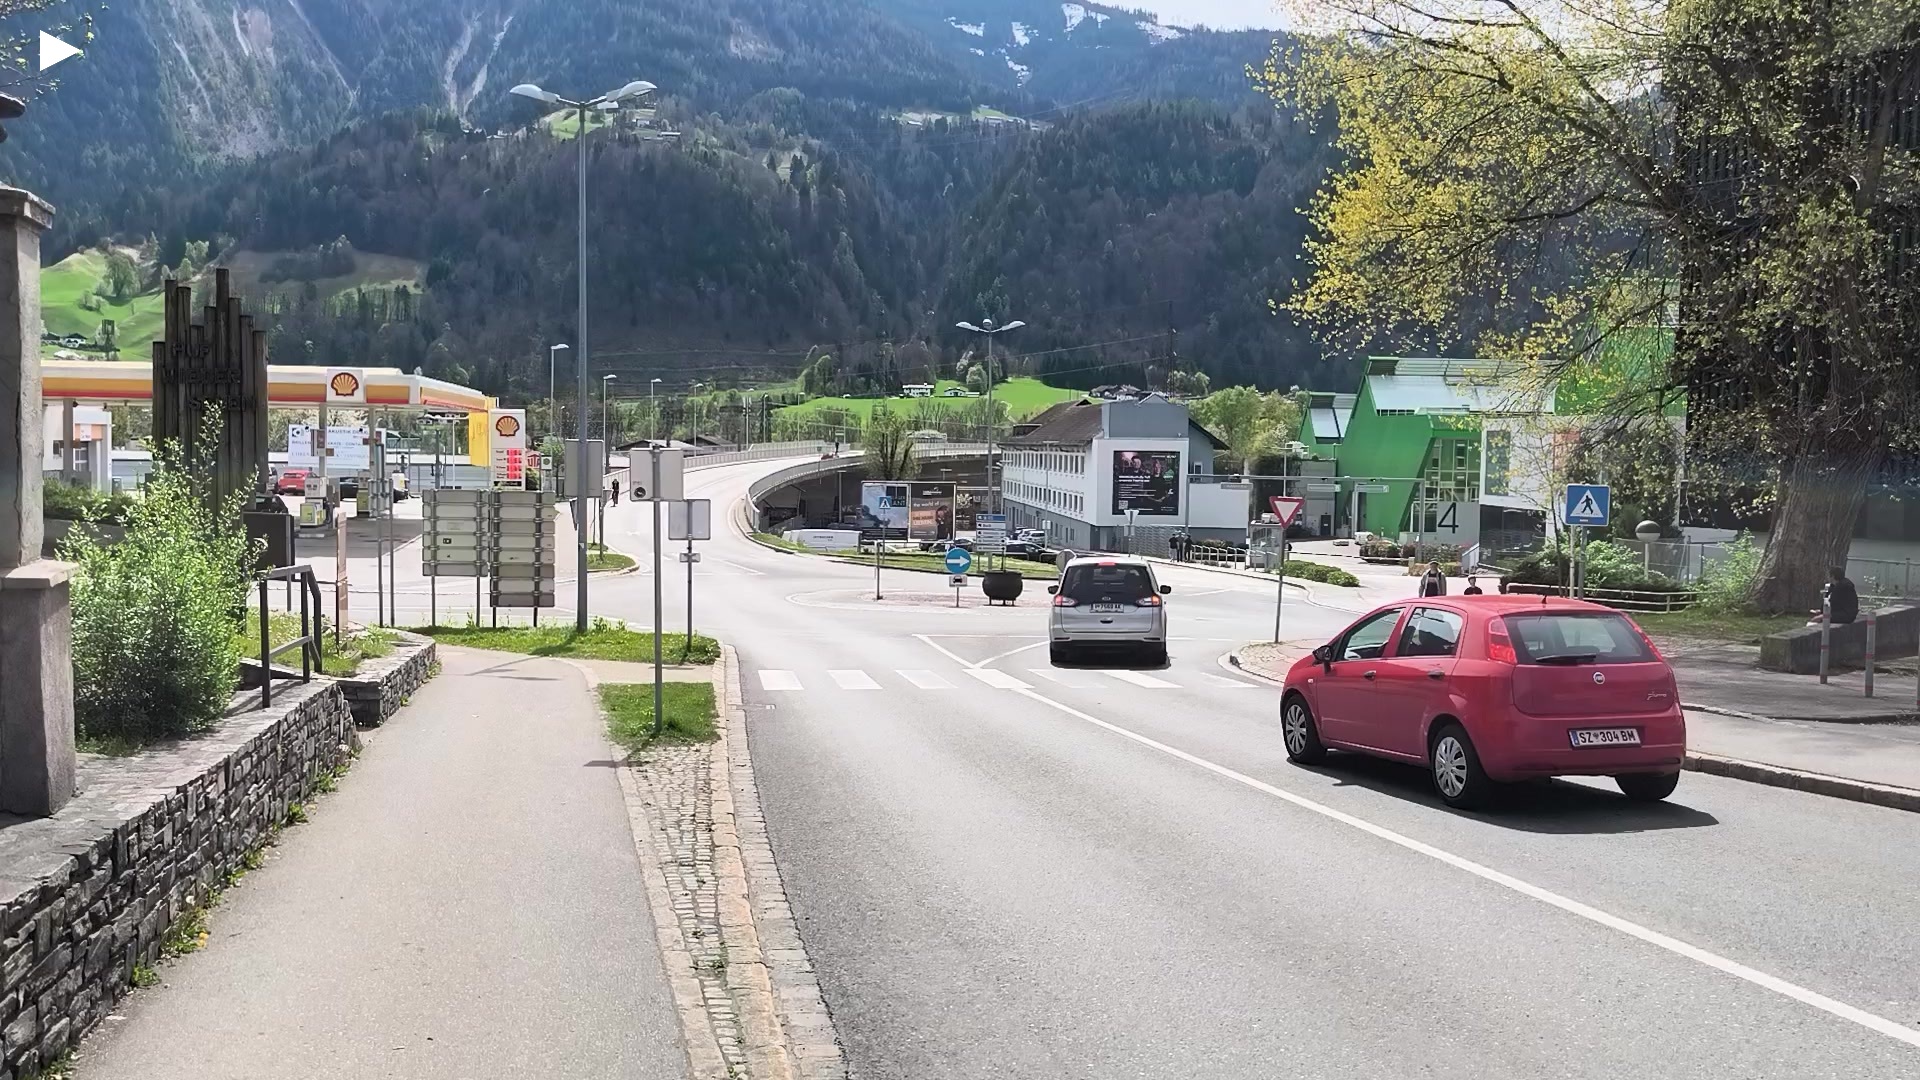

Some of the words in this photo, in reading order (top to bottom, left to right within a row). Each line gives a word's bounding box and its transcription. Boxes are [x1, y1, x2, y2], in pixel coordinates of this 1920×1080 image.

[161, 367, 241, 384] WIEDER
[1438, 502, 1459, 534] 4
[1579, 732, 1594, 744] SZ
[1600, 731, 1620, 743] 304
[1620, 730, 1636, 742] BM
